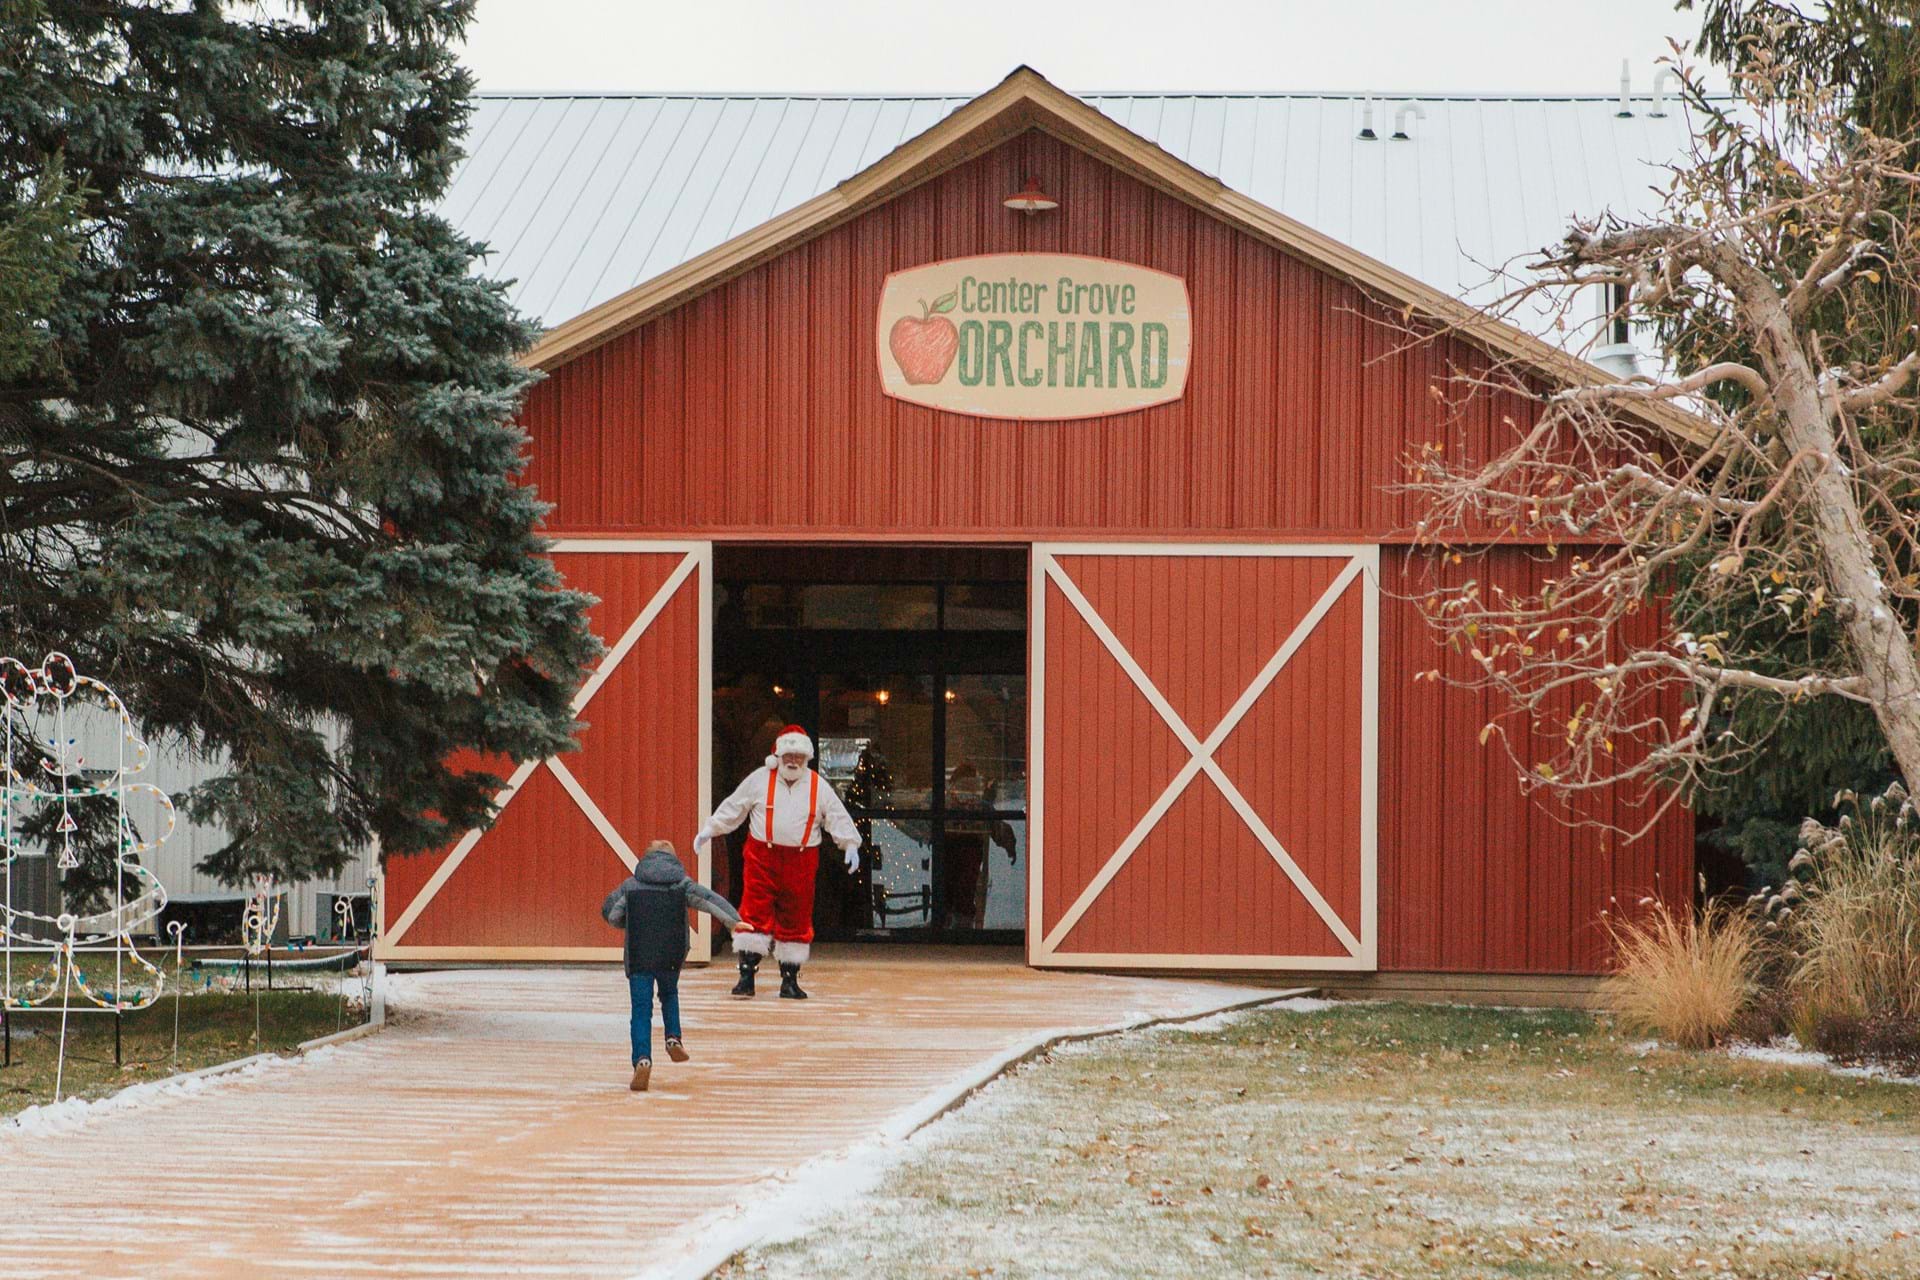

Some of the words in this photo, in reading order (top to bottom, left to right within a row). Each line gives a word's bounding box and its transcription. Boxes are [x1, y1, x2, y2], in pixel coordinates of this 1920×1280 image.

[961, 275, 1048, 314] Center
[1057, 277, 1136, 315] Grove
[958, 319, 1169, 389] ORCHARD
